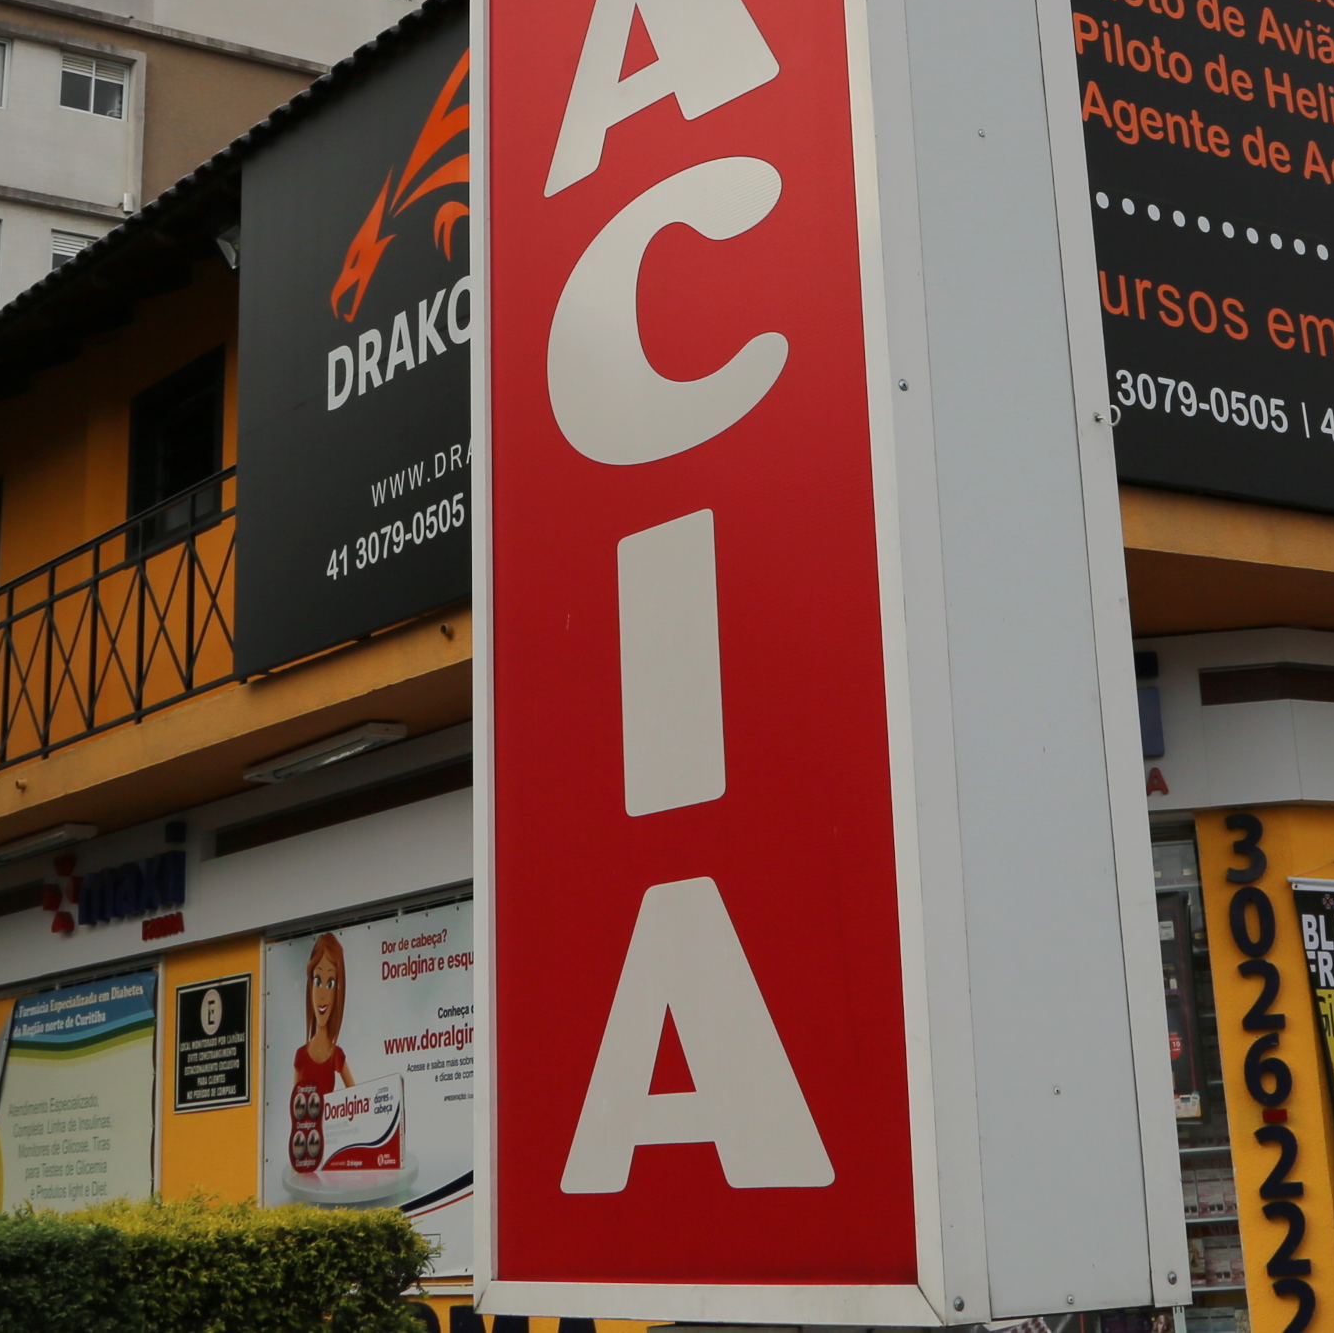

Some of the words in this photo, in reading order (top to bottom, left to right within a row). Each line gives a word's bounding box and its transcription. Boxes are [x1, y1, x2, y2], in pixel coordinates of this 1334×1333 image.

[1072, 12, 1193, 84] Piloto
[1204, 54, 1254, 101] de
[1081, 80, 1231, 157] Agente
[1242, 126, 1291, 173] de
[1099, 270, 1249, 340] ursos
[327, 275, 473, 411] DRAKO
[1116, 369, 1289, 433] 3079-0505
[326, 544, 348, 580] 41
[355, 492, 466, 570] 3079-0505
[78, 820, 186, 926] maxi
[382, 941, 396, 954] Dor
[398, 938, 408, 950] de
[411, 928, 447, 949] cabeça?
[437, 957, 444, 970] e
[50, 992, 96, 1013] Especializada
[98, 993, 110, 1003] em
[111, 984, 144, 1000] Diabetes
[438, 1004, 469, 1018] Conheça
[22, 1021, 44, 1038] Região
[45, 1019, 64, 1032] norte
[65, 1016, 74, 1027] de
[75, 1010, 106, 1026] Curitiba
[407, 1063, 425, 1072] Acesse
[431, 1059, 445, 1069] saiba
[446, 1057, 458, 1067] mais
[439, 1071, 453, 1082] dicas
[454, 1070, 462, 1080] de
[8, 1102, 48, 1117] Atendimento
[324, 1094, 370, 1121] Doralgina
[374, 1094, 389, 1104] dores
[374, 1103, 392, 1115] cabeça
[13, 1123, 44, 1138] Completa
[47, 1119, 65, 1134] Linha
[68, 1119, 76, 1131] de
[18, 1143, 50, 1158] Monitores
[51, 1141, 60, 1155] de
[93, 1136, 110, 1151] Tiras
[25, 1166, 40, 1181] para
[42, 1163, 63, 1177] Testes
[65, 1164, 74, 1176] de
[76, 1160, 107, 1175] Glicemia
[30, 1188, 35, 1200] e
[36, 1185, 66, 1199] Produtos
[68, 1184, 83, 1201] light
[85, 1187, 89, 1196] e
